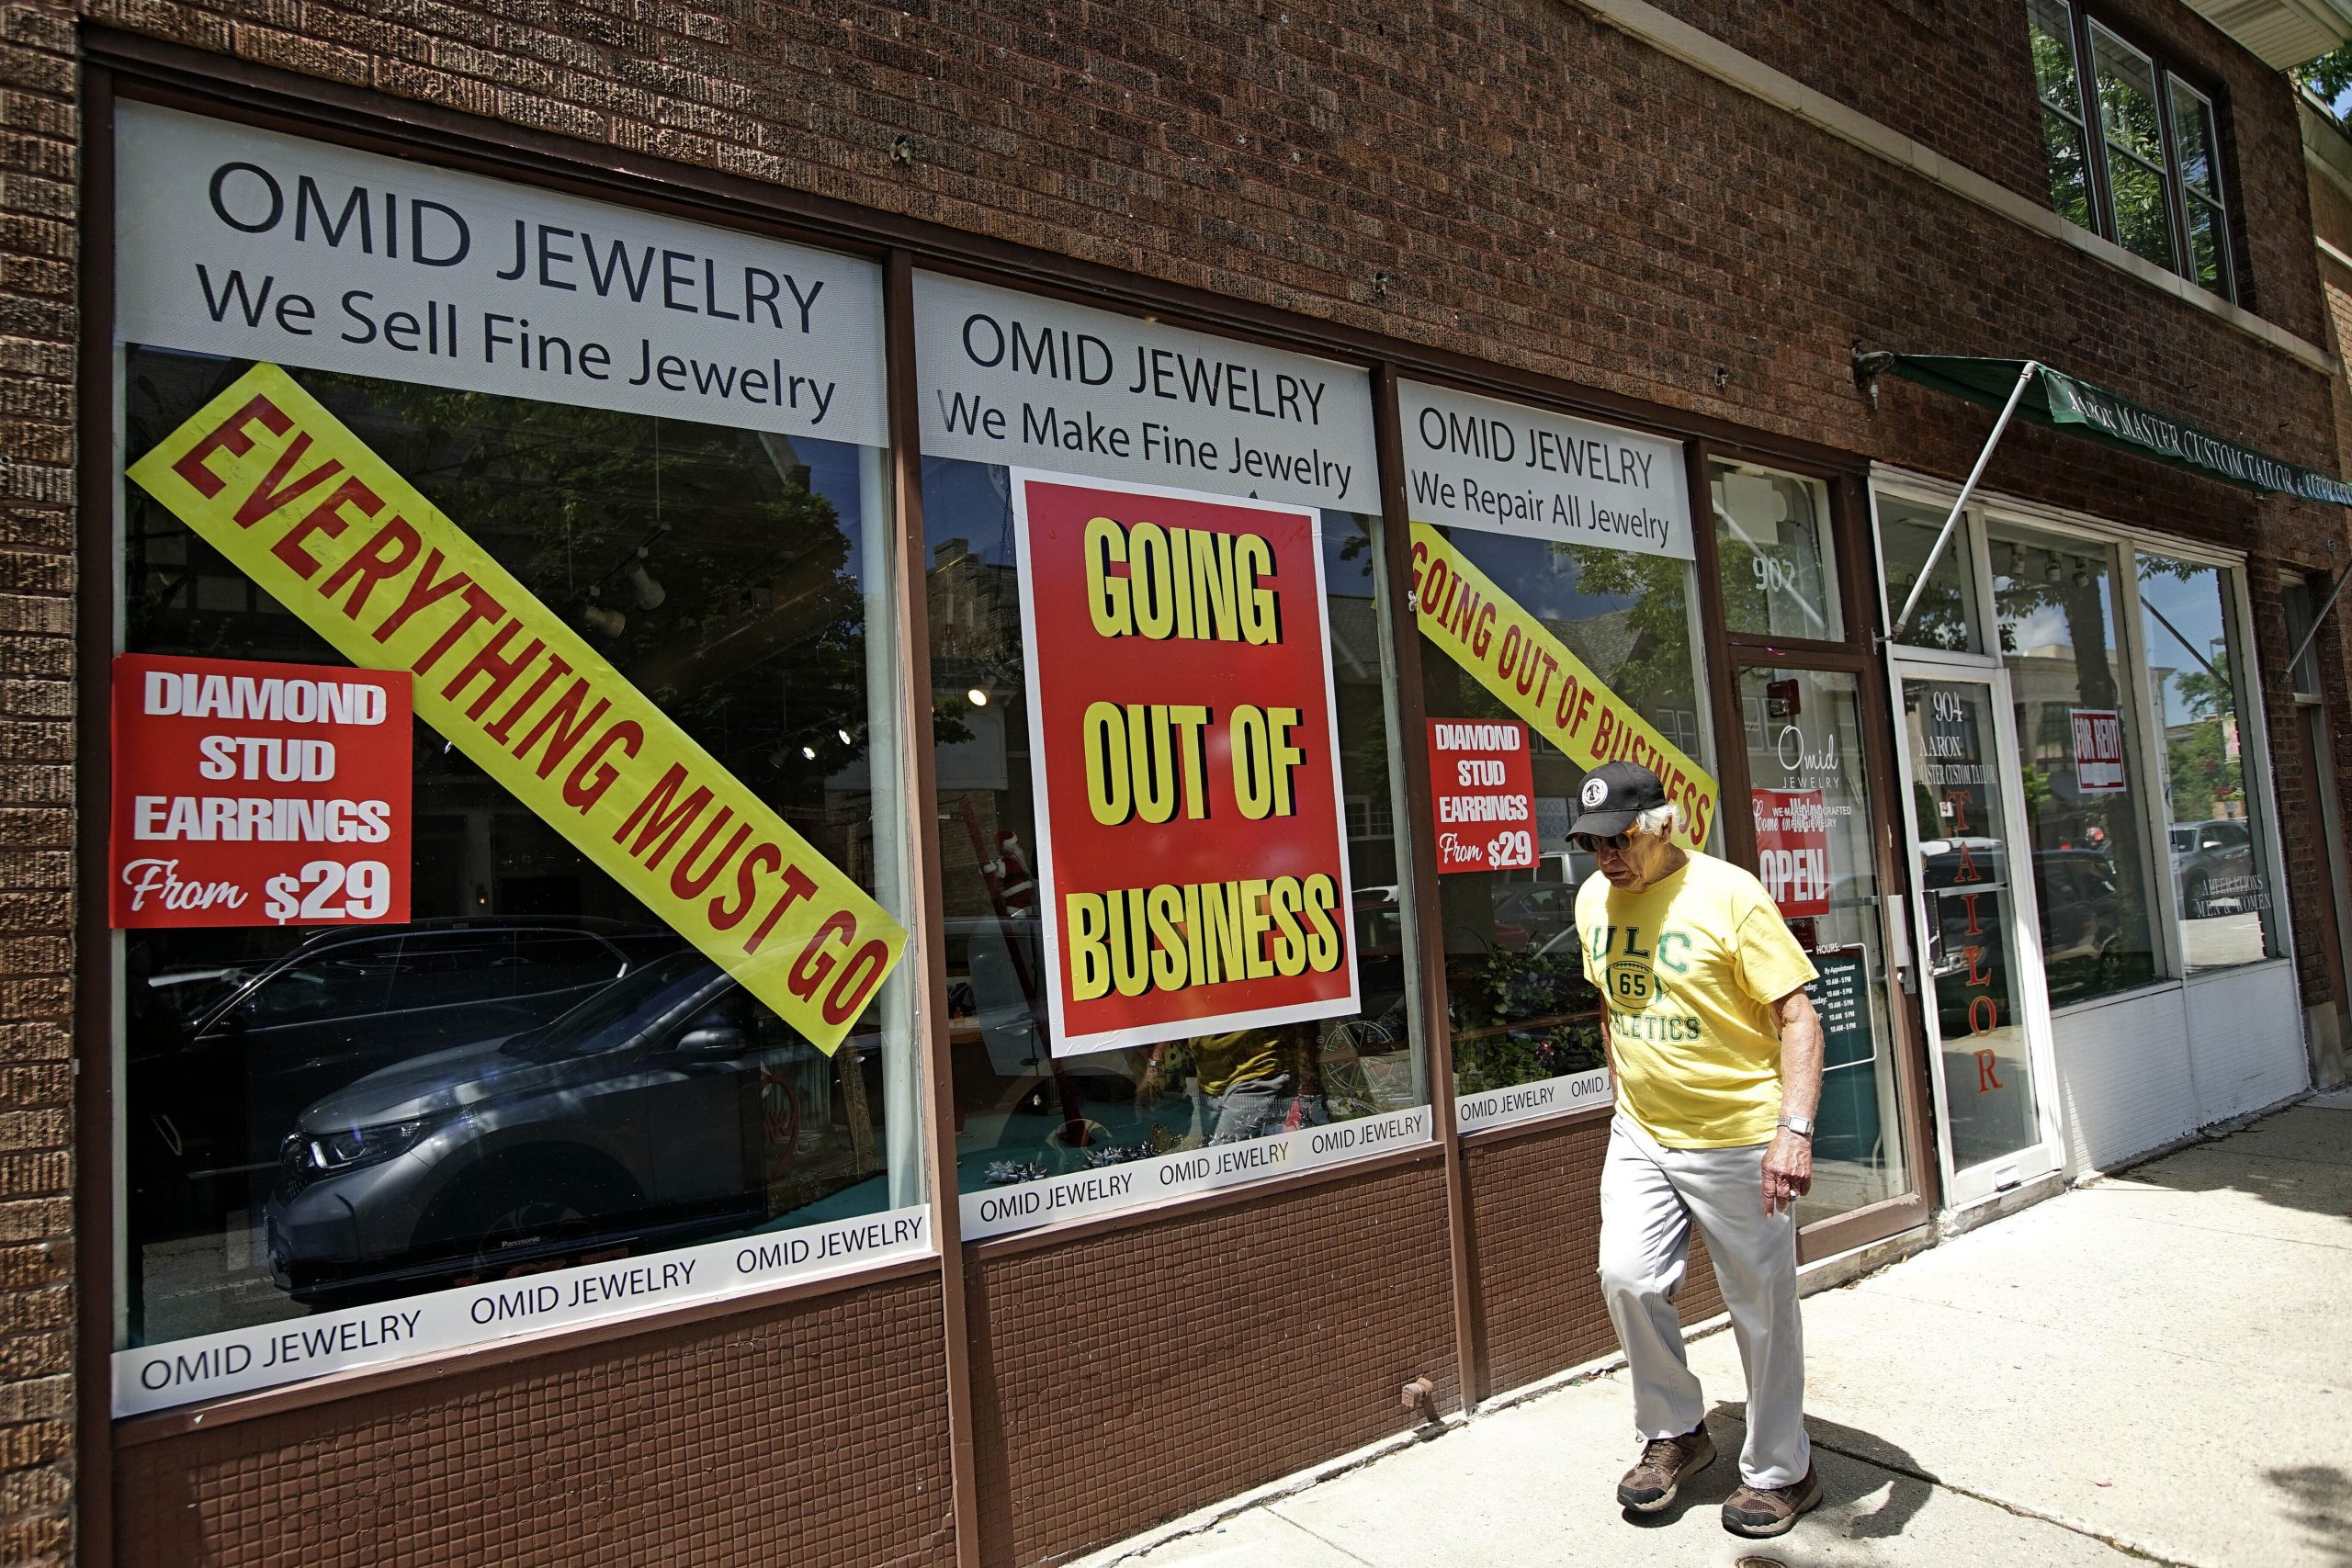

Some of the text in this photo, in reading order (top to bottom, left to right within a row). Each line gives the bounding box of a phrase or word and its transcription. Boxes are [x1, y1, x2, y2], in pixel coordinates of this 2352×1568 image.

[208, 161, 825, 334] OMID JEWELRY
[195, 262, 836, 425] We Sell Fine Jewelry
[962, 313, 1326, 425] OMID JEWELRY
[936, 389, 1351, 500] We Make Fine Jewelry
[1419, 407, 1653, 490] OMID JEWELRY
[2115, 403, 2187, 457] MASTER
[2184, 430, 2247, 479] CUSTOM
[2245, 453, 2297, 495] TAILOR
[1410, 468, 1669, 548] We Repair All Jewelry
[1084, 516, 1283, 645] GOING
[1412, 541, 1497, 661] GOING
[1498, 625, 1558, 709] OUT
[1556, 674, 1595, 739] OF
[144, 671, 387, 726] DIAMOND
[171, 392, 888, 1025] EVERYTHING MUST GO
[1933, 691, 1963, 722] 904
[199, 735, 335, 782] STUD
[1435, 724, 1521, 751] DIAMOND
[1778, 724, 1838, 771] Omid
[1918, 735, 1962, 757] AARON
[2074, 718, 2120, 760] FOR RENT
[1083, 701, 1306, 826] OUT OF
[1457, 760, 1506, 787] STUD
[1782, 776, 1839, 789] JEWELRY
[1917, 763, 1997, 785] MASTER CUSTOM TAILOR
[134, 795, 390, 842] EARRINGS
[1439, 795, 1529, 822] EARRINGS
[1752, 798, 1779, 835] Come
[1772, 807, 1783, 817] WE
[1784, 807, 1803, 817] MAKE
[1439, 830, 1532, 870] From $29
[122, 858, 390, 925] From $29
[1759, 848, 1826, 903] OPEN
[2202, 874, 2263, 896] ALTERATIONS
[2233, 893, 2271, 912] WOMEN
[1066, 873, 1342, 1002] BUSINESS
[1816, 942, 1840, 955] HOURS:
[1946, 789, 2004, 1093] TAILOR
[1619, 973, 1646, 997] 65
[1460, 1086, 1555, 1122] OMID JEWELRY
[1571, 1076, 1604, 1098] OMID
[1311, 1114, 1422, 1155] OMID JEWELRY
[1159, 1142, 1289, 1186] OMID JEWELRY
[980, 1172, 1132, 1222] OMID JEWELRY
[502, 1235, 541, 1248] Panasonic
[737, 1216, 922, 1274] OMID JEWELRY
[470, 1286, 559, 1325] OMID
[568, 1259, 696, 1307] JEWELRY
[141, 1309, 422, 1390] OMID JEWELRY
